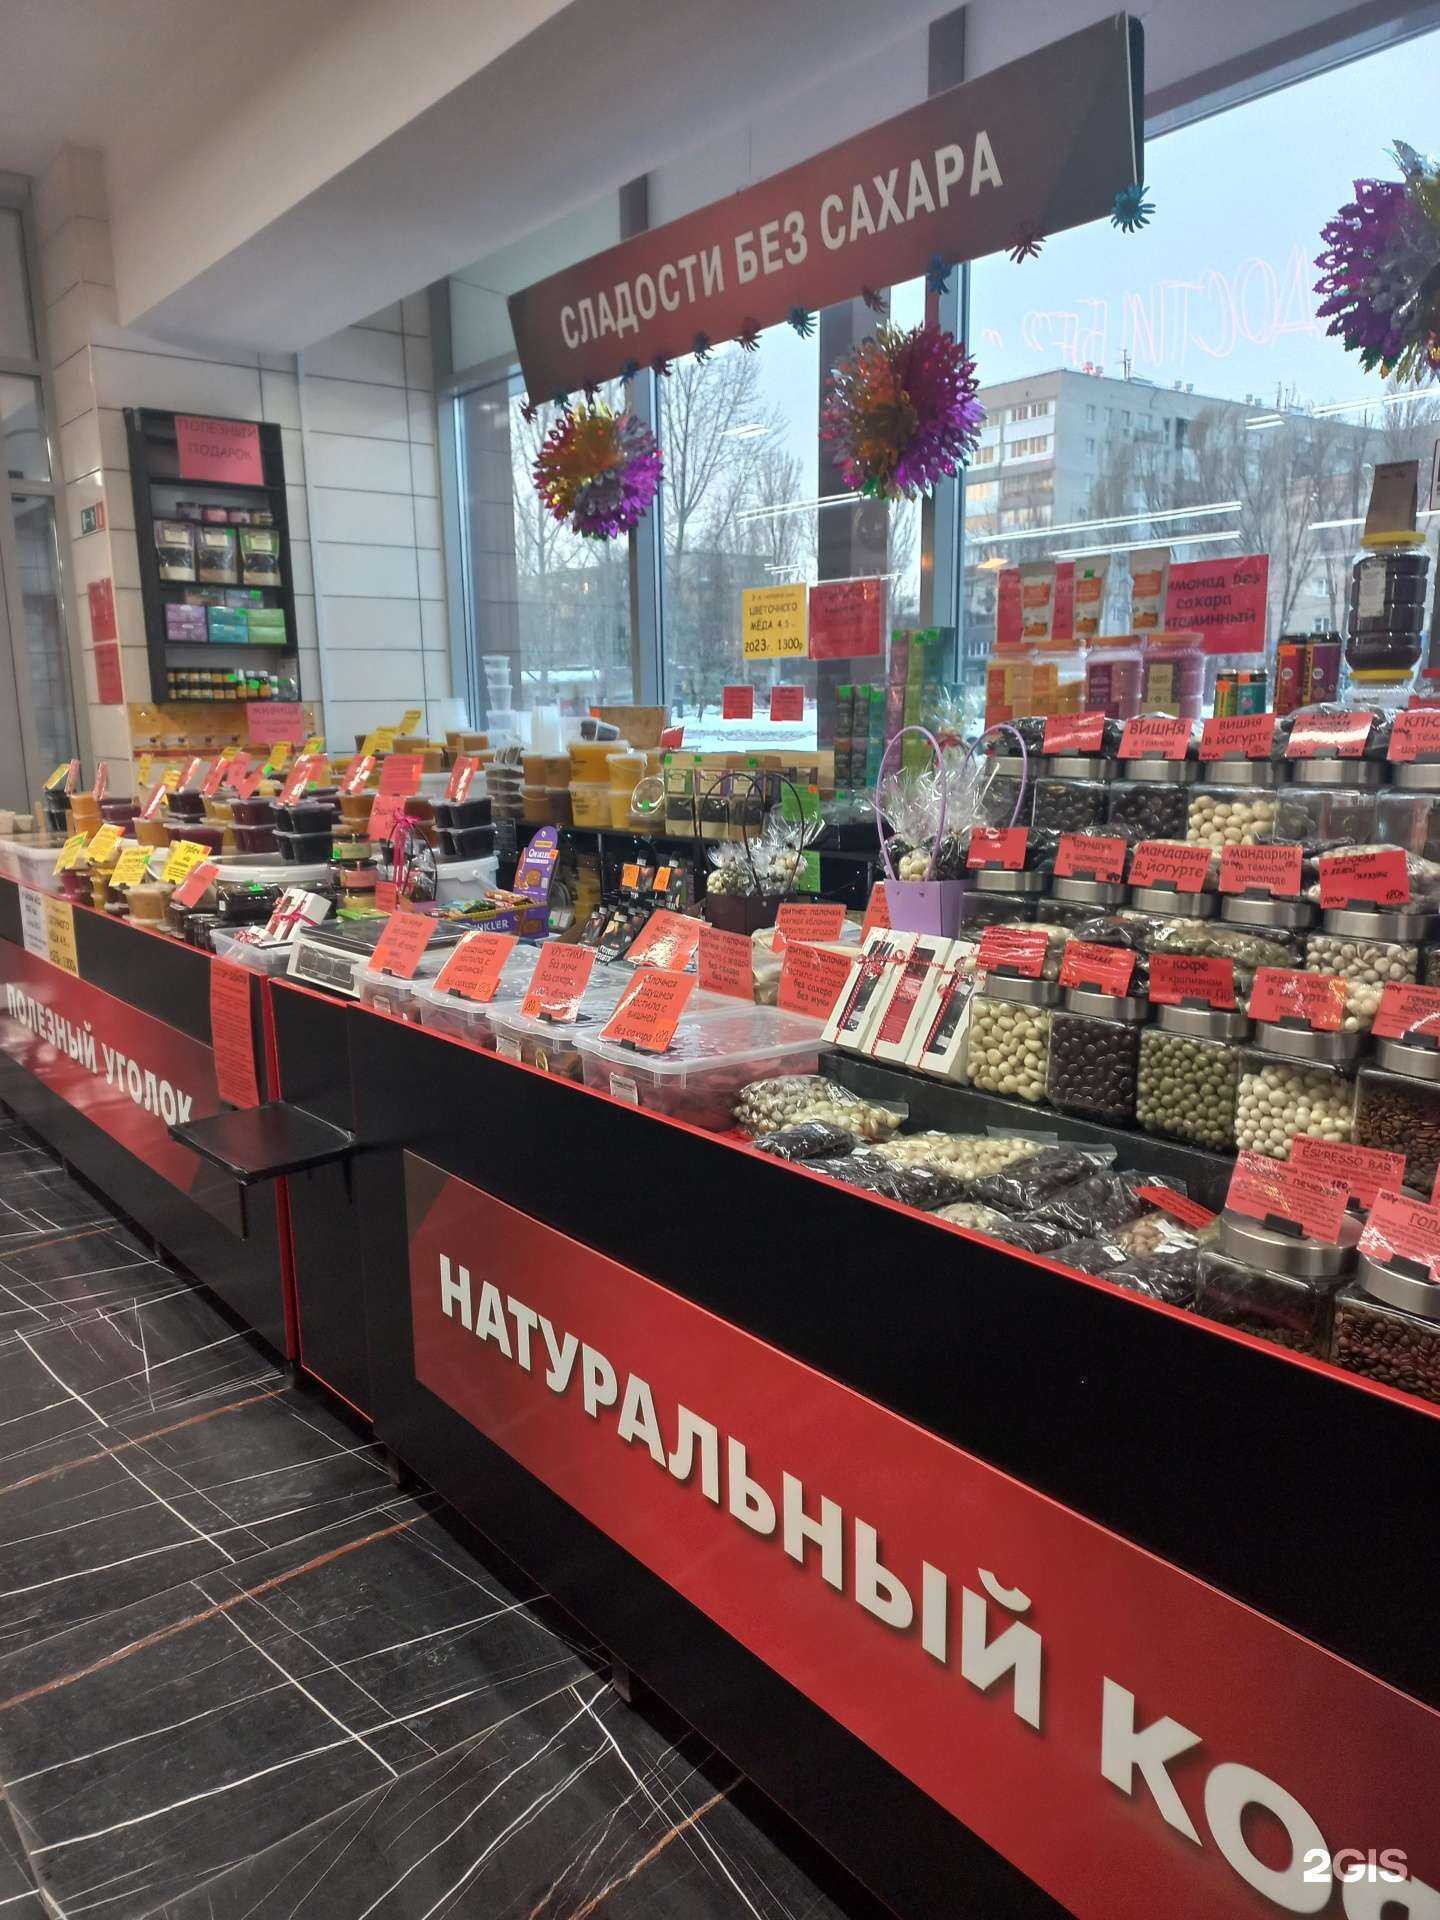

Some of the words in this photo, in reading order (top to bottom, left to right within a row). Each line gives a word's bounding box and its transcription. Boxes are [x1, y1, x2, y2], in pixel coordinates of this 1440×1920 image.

[560, 245, 725, 349] СЛАДОСТИ
[734, 210, 808, 284] БЕЗ
[819, 130, 1004, 252] САХАРА
[1176, 595, 1232, 611] сахара
[1172, 959, 1209, 974] кофе
[6, 982, 98, 1074] ПОЛЕЗНЫЙ
[101, 1042, 193, 1126] УГОЛОК
[1302, 1146, 1363, 1168] ESPRESSO
[1367, 1160, 1392, 1172] BAR
[439, 1253, 1042, 1730] НАТУРАЛЬНЫЙ
[1101, 1675, 1440, 1920] КО
